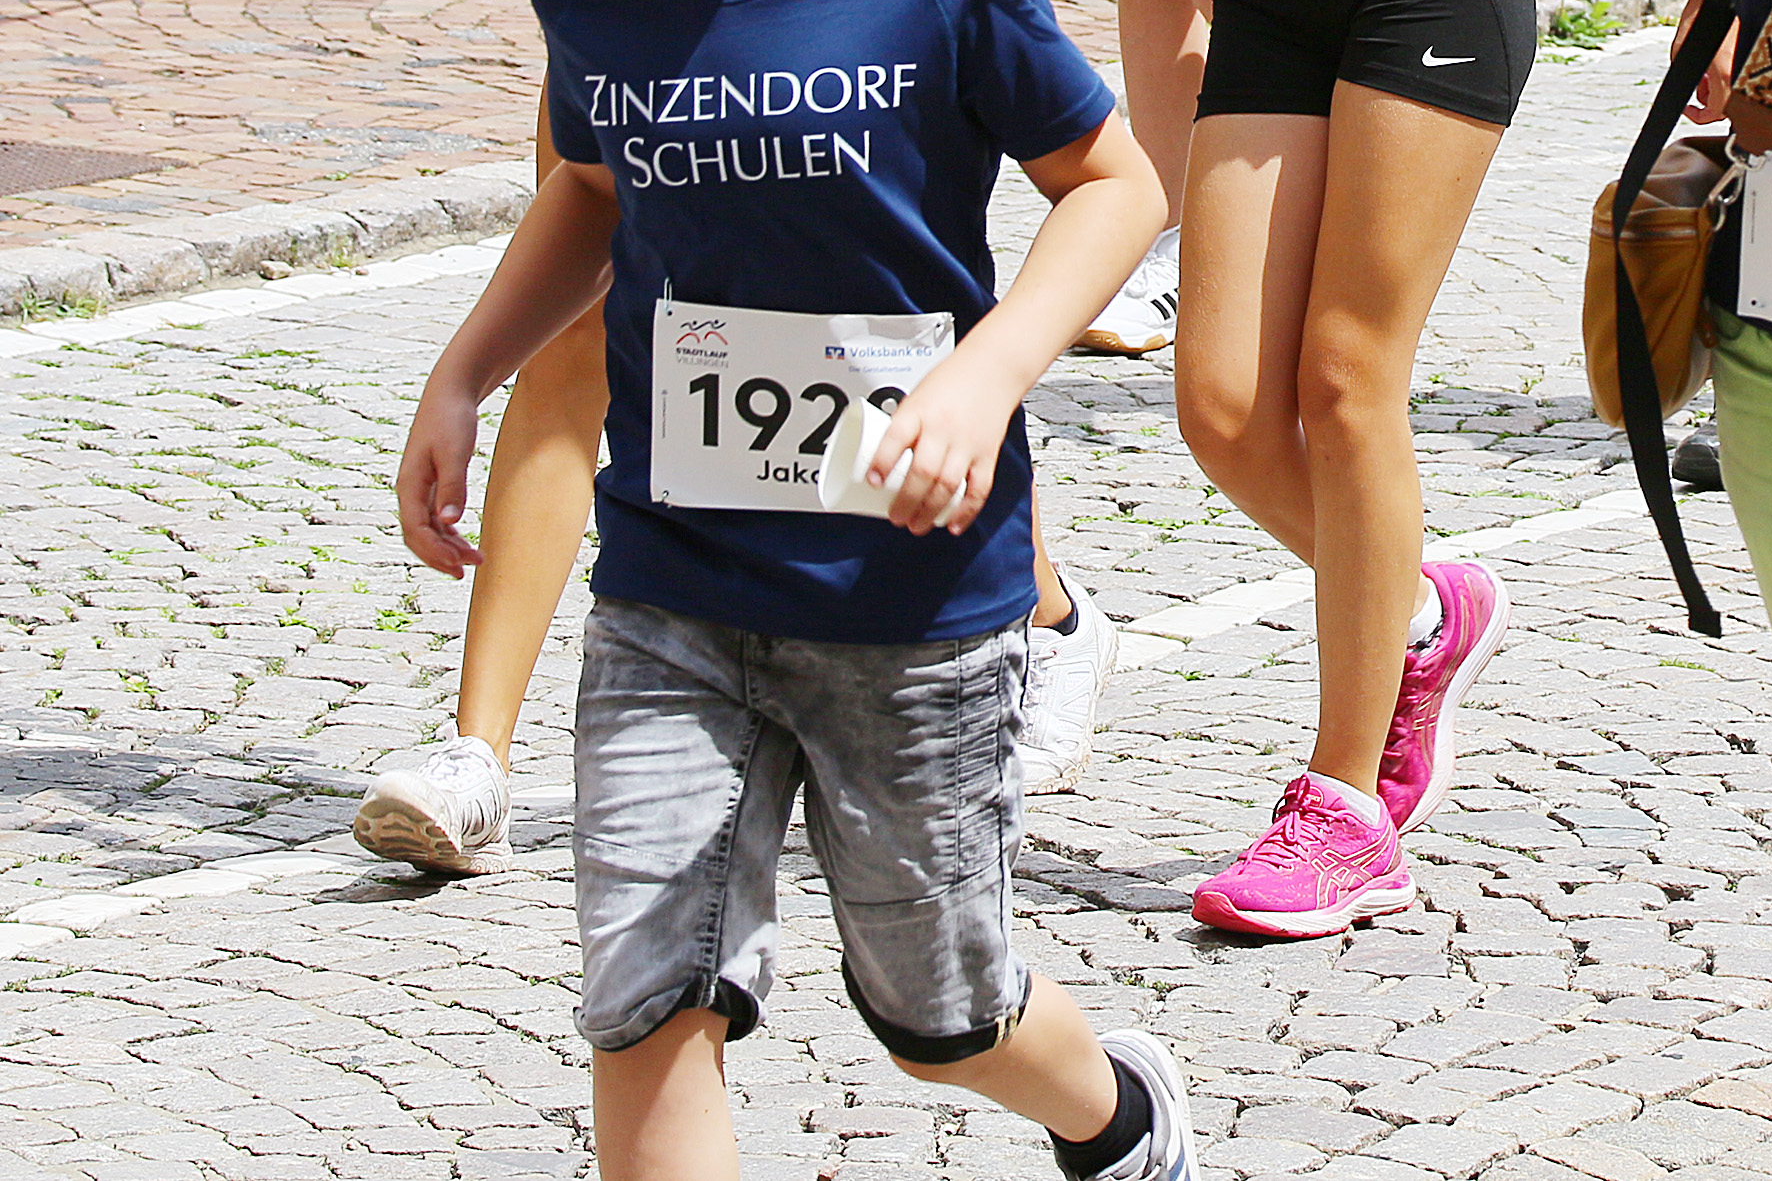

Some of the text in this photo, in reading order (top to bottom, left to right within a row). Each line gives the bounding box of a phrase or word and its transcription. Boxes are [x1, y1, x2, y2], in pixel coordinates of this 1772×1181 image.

[585, 63, 917, 126] ZINZENDORF
[623, 130, 870, 189] SCHULEN
[850, 345, 933, 358] Volksbank eG
